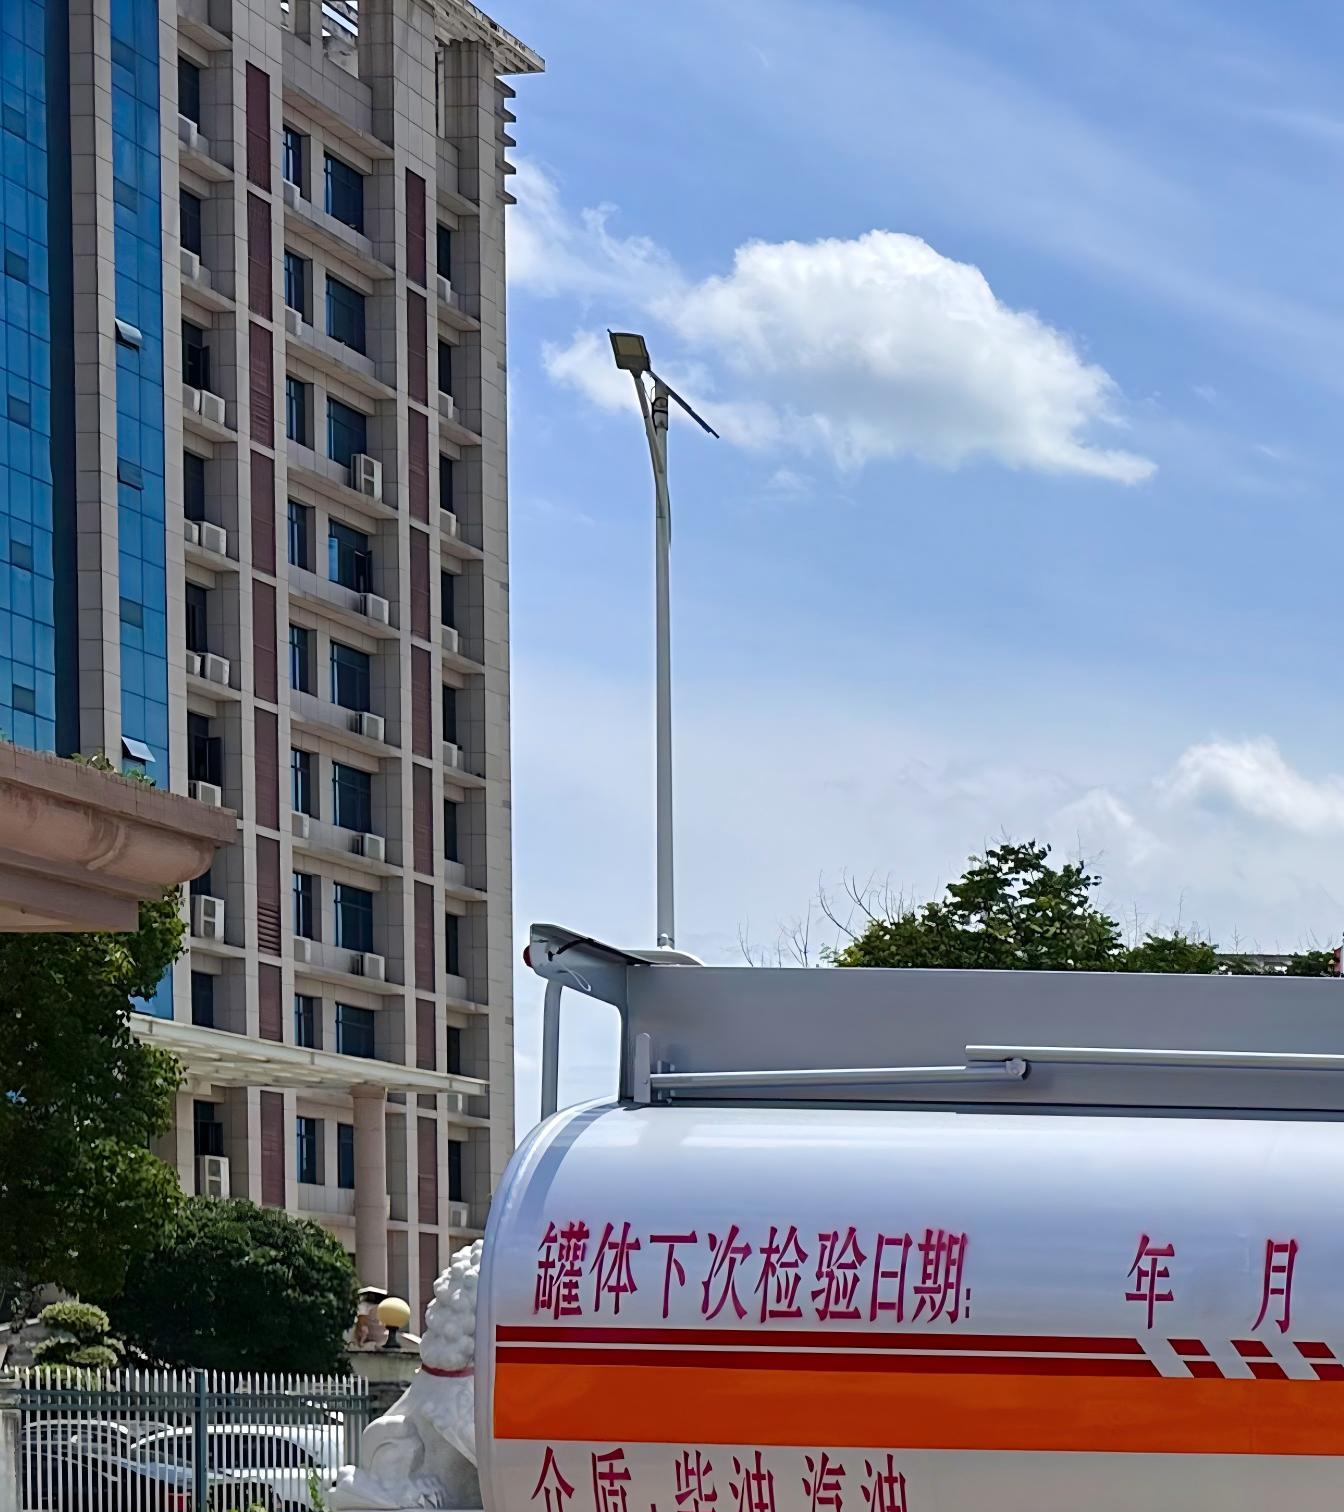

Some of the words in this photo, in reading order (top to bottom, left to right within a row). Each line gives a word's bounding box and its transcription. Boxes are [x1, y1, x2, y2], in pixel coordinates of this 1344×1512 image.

[533, 1220, 971, 1323] 罐体下次检验日期:
[1125, 1234, 1175, 1330] 年
[1252, 1238, 1299, 1333] 月
